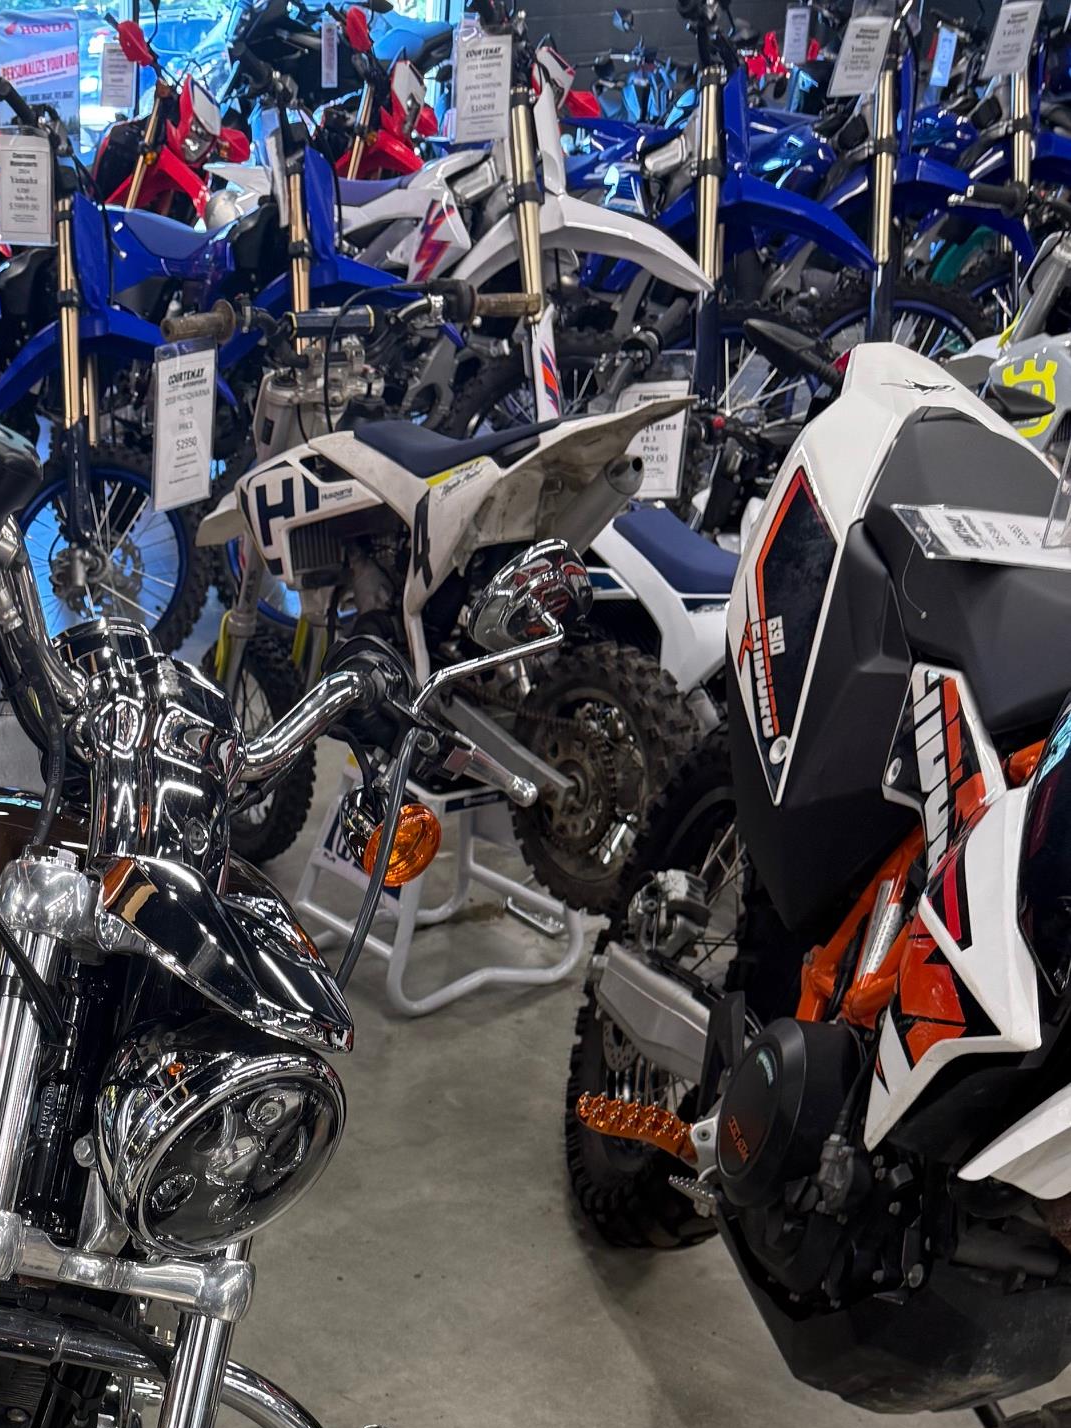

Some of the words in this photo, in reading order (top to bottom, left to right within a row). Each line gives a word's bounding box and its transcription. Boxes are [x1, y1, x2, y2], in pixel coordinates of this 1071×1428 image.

[20, 22, 73, 34] HONDA
[466, 46, 502, 58] COURTENAY
[168, 368, 205, 386] COURTENAY
[177, 388, 211, 402] HUSQVARNA
[643, 423, 677, 434] qvarna
[176, 436, 198, 451] $2950
[321, 488, 353, 501] Husqvarna
[767, 615, 786, 656] 690
[750, 618, 780, 739] ENDURO
